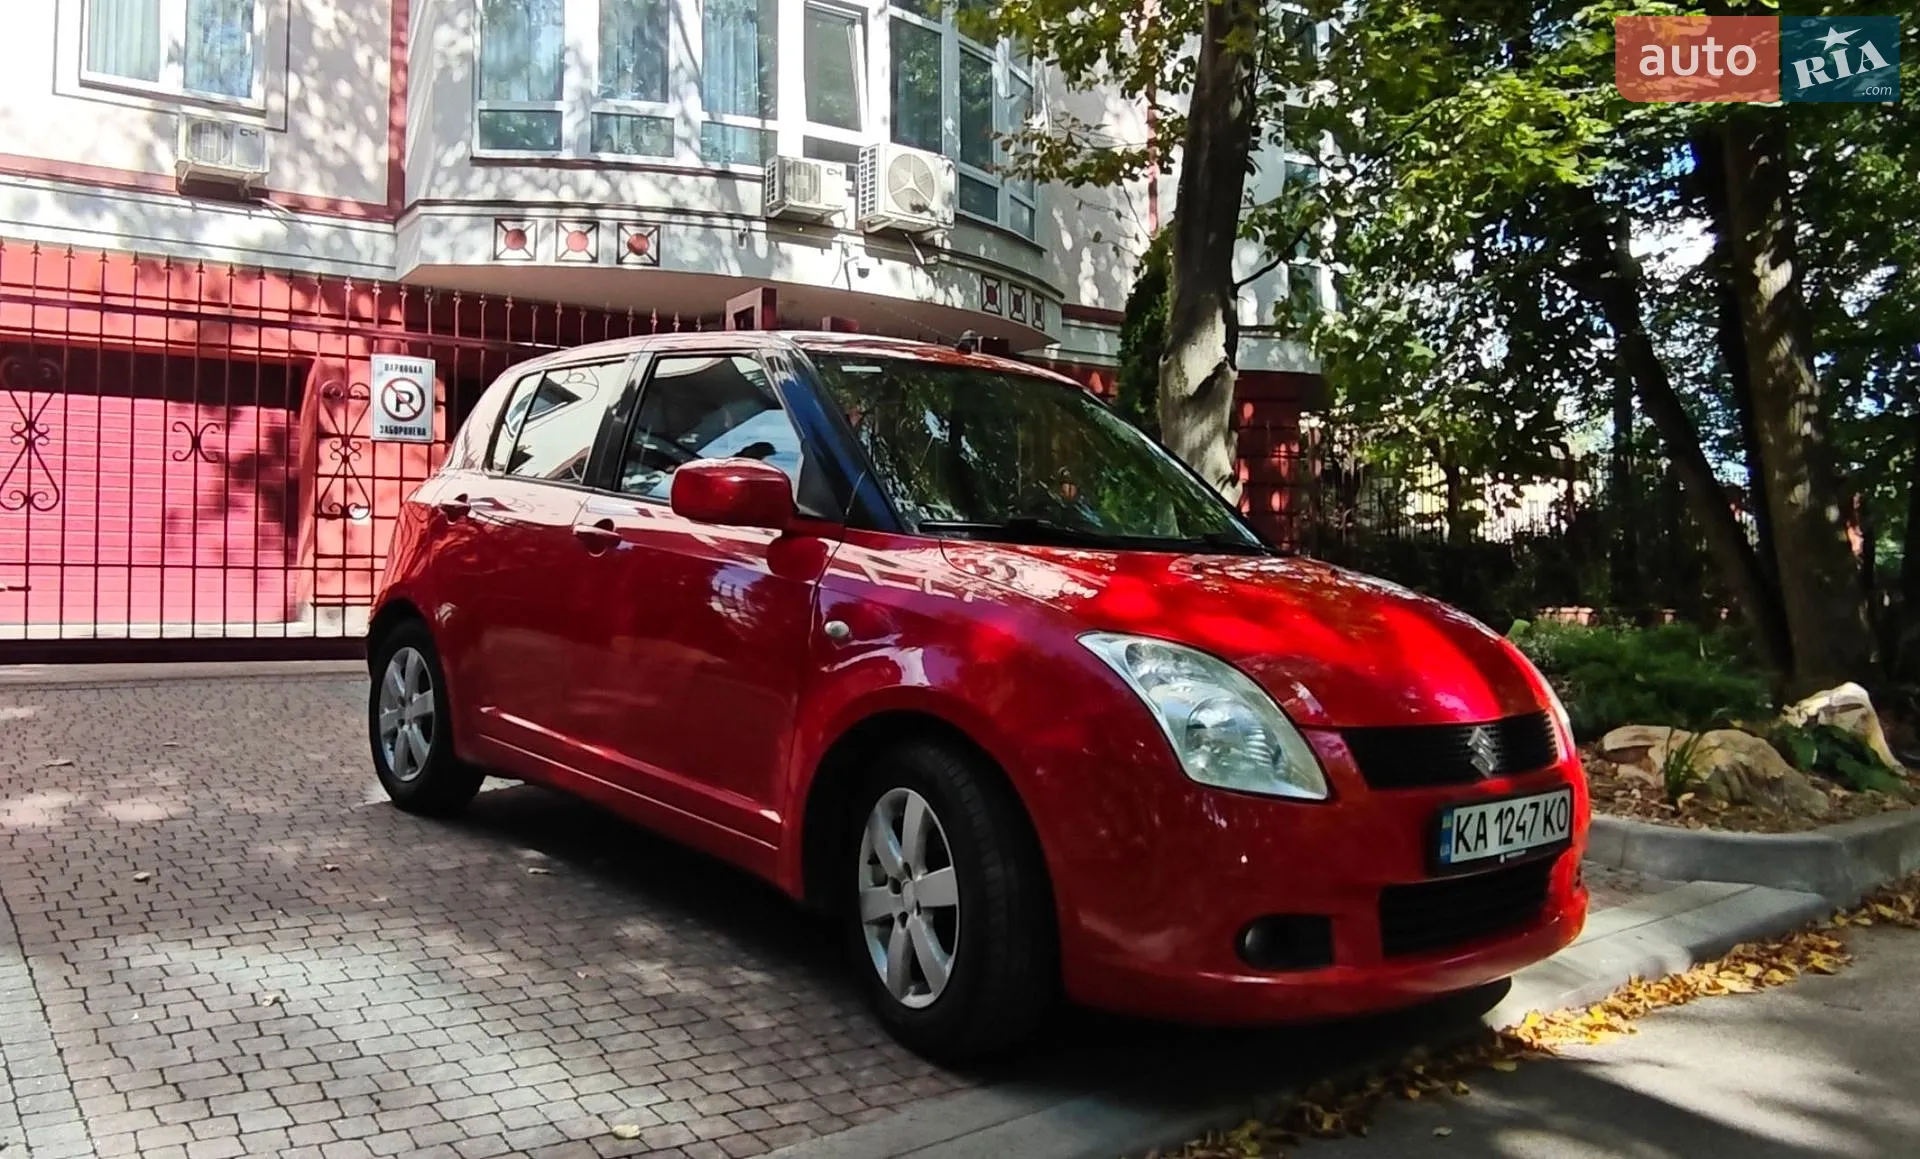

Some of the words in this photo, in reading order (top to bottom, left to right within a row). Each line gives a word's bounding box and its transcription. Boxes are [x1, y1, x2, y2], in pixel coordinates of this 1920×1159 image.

[1455, 811, 1488, 855] KA
[1494, 801, 1540, 846] 1247
[1543, 796, 1569, 837] KO
